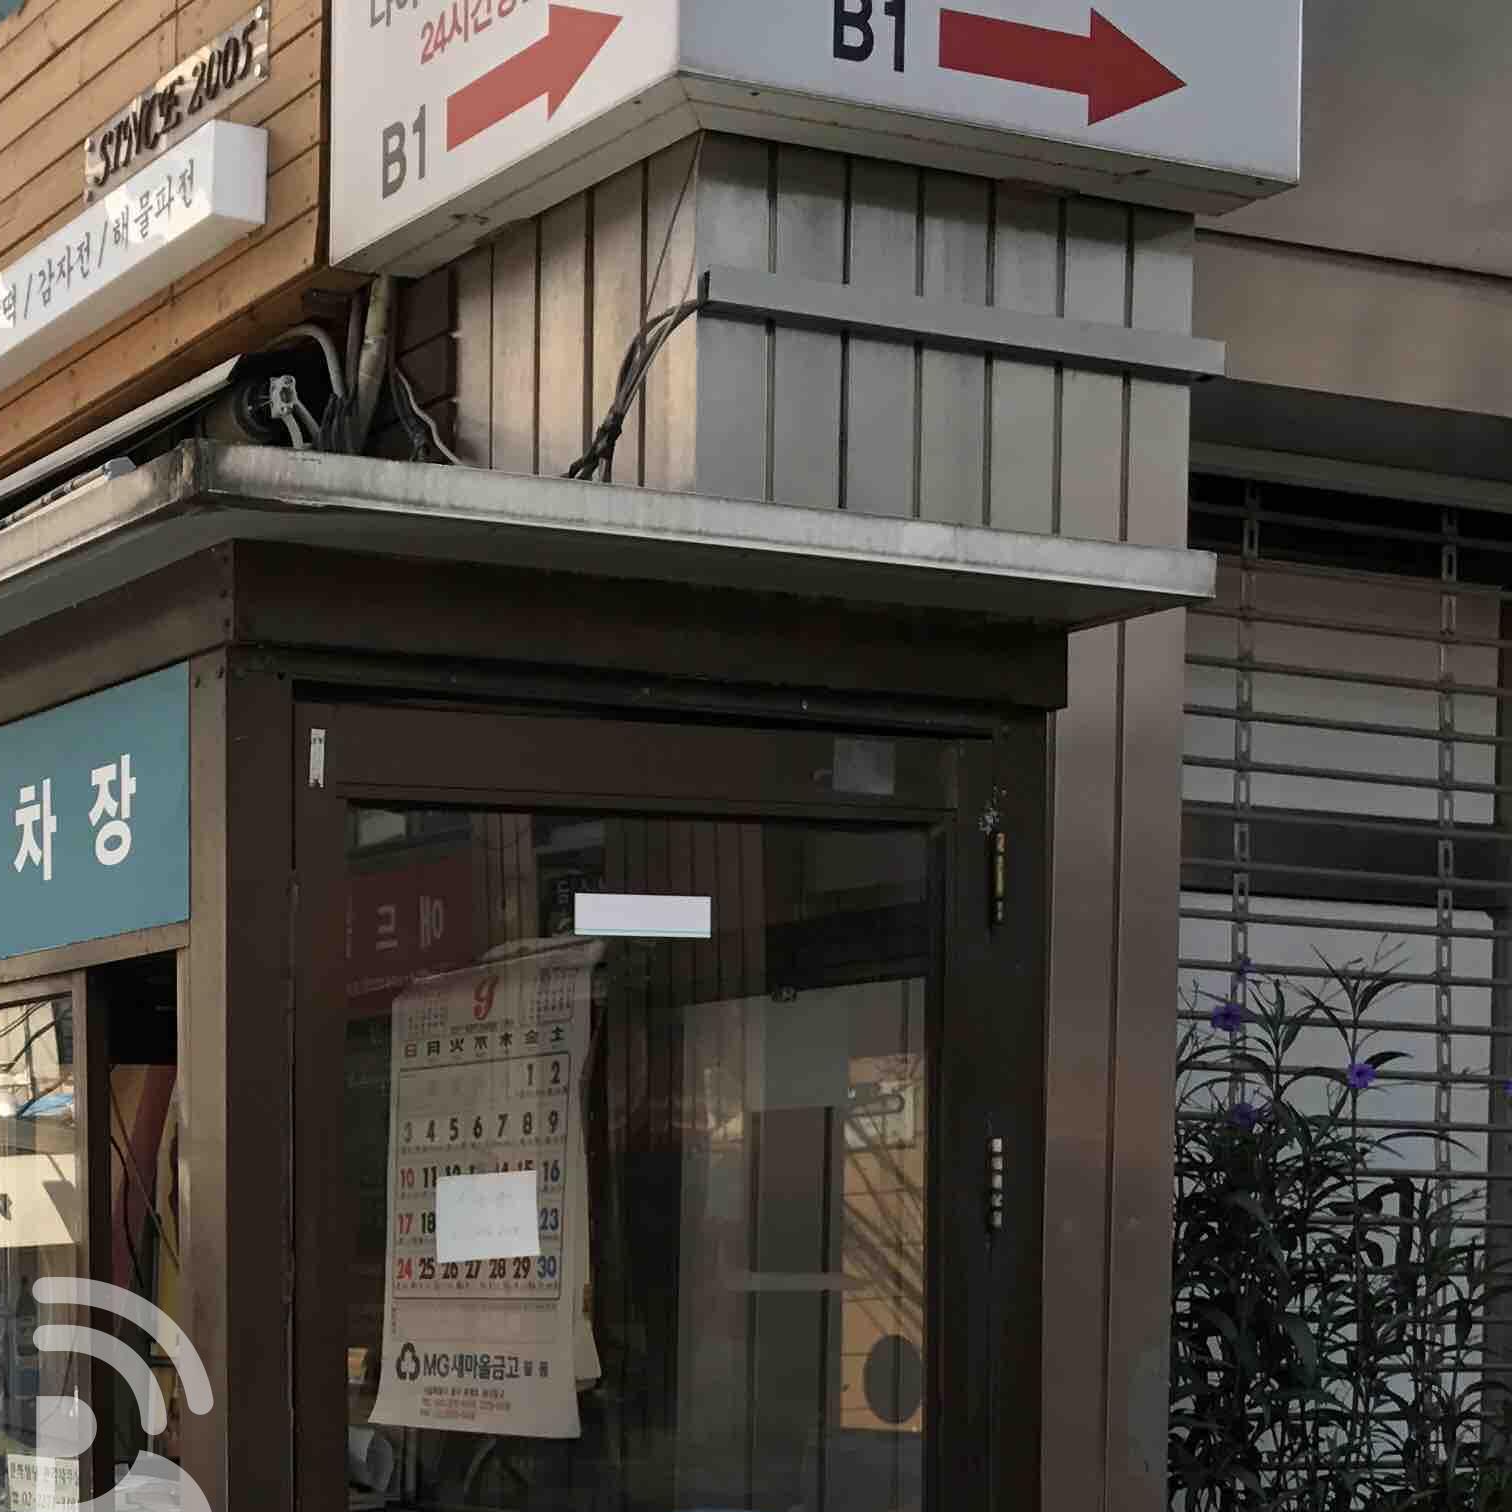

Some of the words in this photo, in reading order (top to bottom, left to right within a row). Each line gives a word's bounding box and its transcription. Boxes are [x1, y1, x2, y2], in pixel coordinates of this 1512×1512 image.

[833, 0, 906, 73] B1
[94, 75, 185, 187] SINCE
[188, 20, 257, 115] 2005
[382, 103, 426, 200] B1
[550, 1060, 561, 1085] 2
[403, 1122, 413, 1144] 3
[425, 1119, 436, 1143] 4
[449, 1118, 459, 1142] 5
[473, 1116, 484, 1139] 6
[497, 1113, 509, 1137] 7
[522, 1111, 533, 1135] 8
[548, 1110, 559, 1133] 9
[400, 1167, 415, 1188] 10
[422, 1167, 437, 1188] 11
[542, 1160, 561, 1182] 16
[398, 1213, 413, 1235] 17
[421, 1212, 436, 1234] 18
[539, 1208, 559, 1231] 23
[396, 1258, 413, 1281] 24
[418, 1257, 436, 1280] 25
[442, 1261, 459, 1280] 26
[464, 1260, 483, 1279] 27
[489, 1258, 507, 1279] 28
[512, 1257, 531, 1279] 29
[537, 1256, 558, 1279] 30
